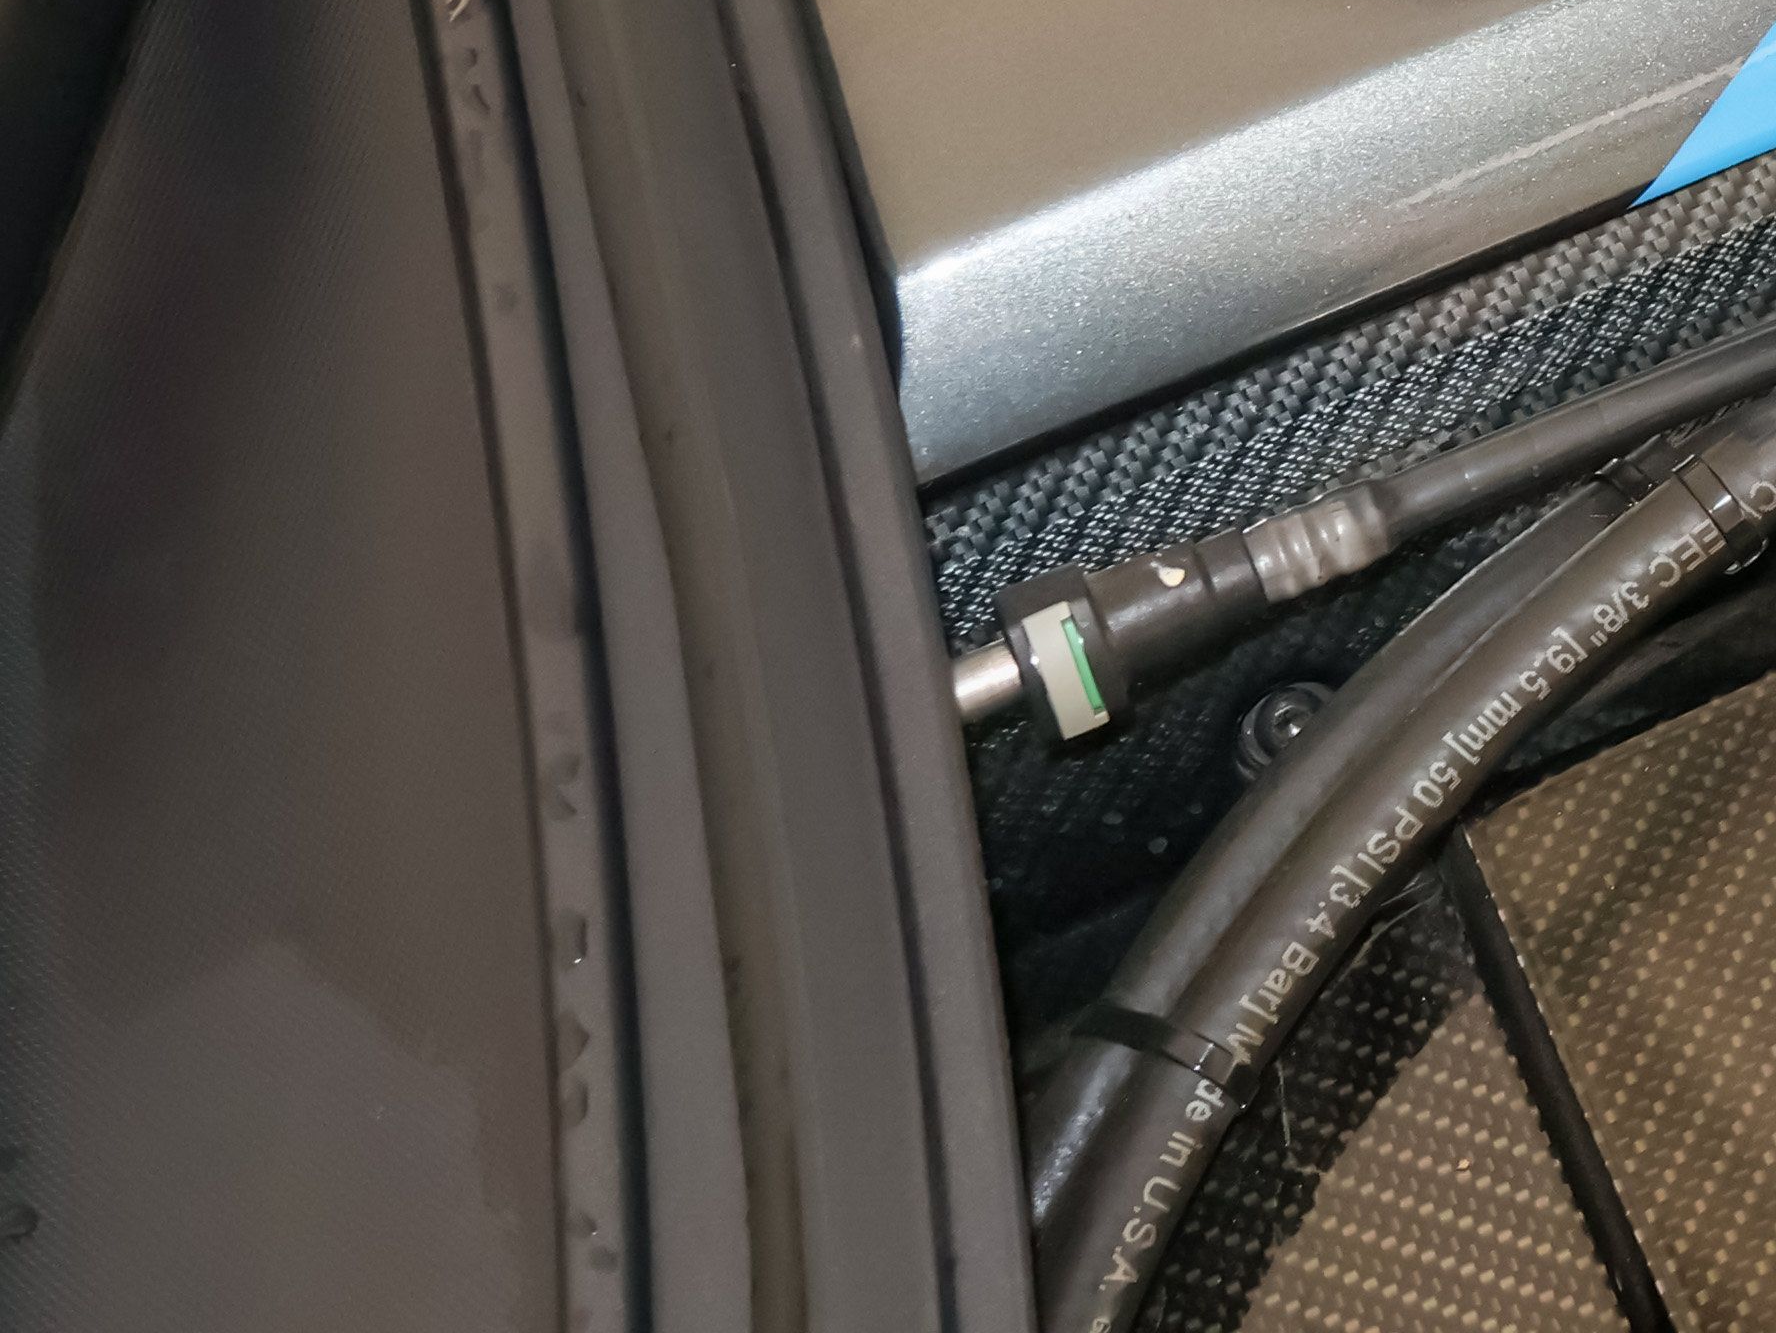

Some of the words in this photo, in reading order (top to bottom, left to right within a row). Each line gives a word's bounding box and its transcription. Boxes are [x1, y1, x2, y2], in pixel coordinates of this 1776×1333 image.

[1649, 518, 1727, 588] EEC
[1590, 581, 1650, 647] 3/8"
[1519, 626, 1589, 701] [9.5
[1441, 691, 1523, 766] mm]
[1412, 760, 1462, 808] 50
[1357, 805, 1424, 875] PSI
[1305, 864, 1372, 939] [3.4
[1238, 941, 1320, 1025] Bar]
[1185, 1022, 1265, 1122] Mde
[1160, 1131, 1203, 1168] in
[1099, 1175, 1181, 1291] U.S.A.
